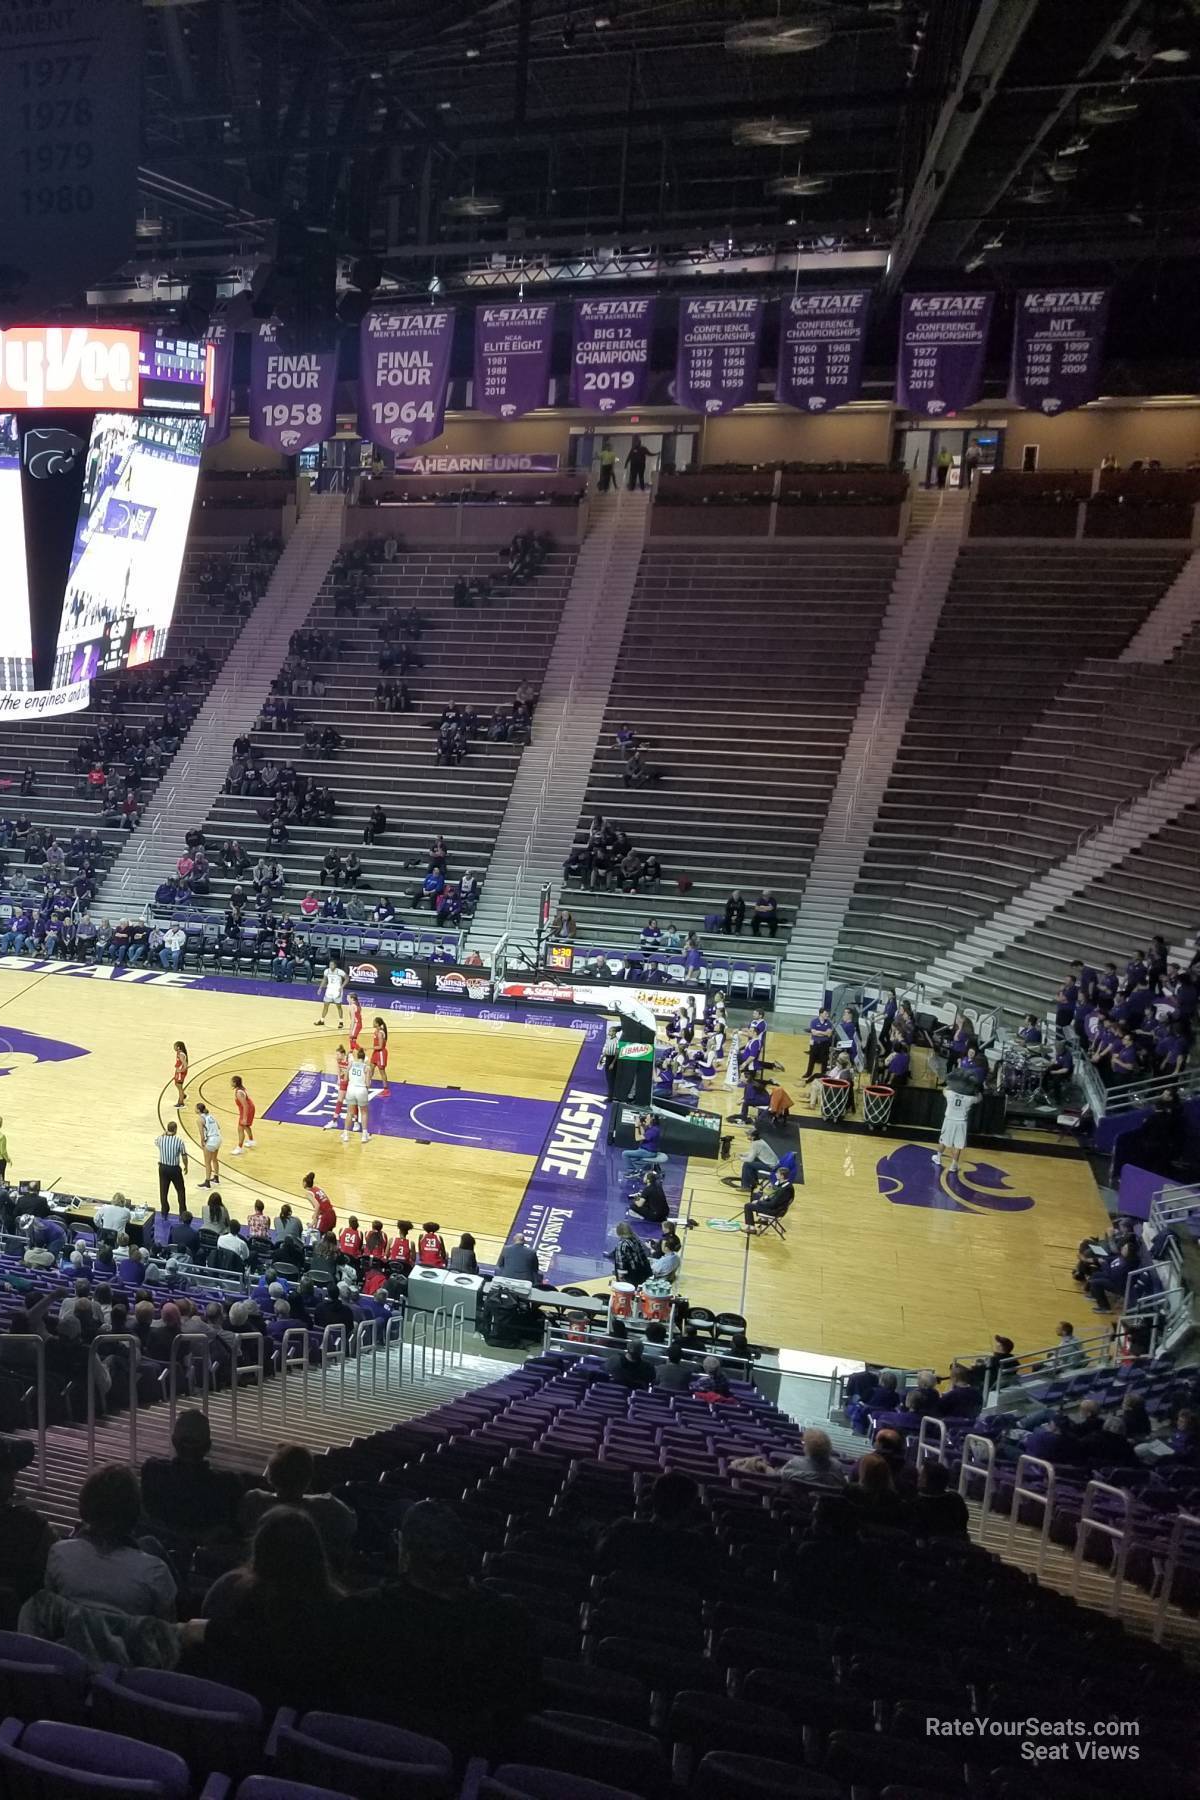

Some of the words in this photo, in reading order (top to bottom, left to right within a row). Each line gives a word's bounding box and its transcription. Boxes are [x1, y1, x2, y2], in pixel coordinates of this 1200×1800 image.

[17, 54, 92, 90] 1977
[19, 97, 94, 131] 1978
[20, 141, 94, 174] 1979
[20, 184, 94, 216] 1980
[790, 294, 863, 311] K-STATE
[909, 297, 986, 311] K-STATE
[1024, 291, 1105, 307] K-STATE
[581, 300, 648, 315] K-STATE
[687, 300, 758, 314] K-STATE
[483, 307, 548, 322] K-STATE
[368, 314, 448, 331] K-STATE
[796, 320, 854, 329] CONFERENCE
[916, 322, 976, 331] CONFERENCE
[1050, 319, 1076, 331] NIT
[373, 330, 395, 338] MEN'S
[396, 329, 441, 337] BASKETBALL
[594, 329, 614, 339] BIG
[617, 328, 631, 338] 12
[685, 332, 756, 342] CHAMPIONSHIPS
[787, 328, 861, 338] CHAMPIONSHIPS
[906, 331, 983, 340] CHAMPIONSHIPS
[484, 341, 511, 352] ELITE
[512, 340, 542, 350] EIGHT
[577, 340, 647, 351] CONFERENCE
[794, 345, 817, 353] 1960
[1028, 344, 1053, 352] 1976
[1065, 342, 1090, 350] 1999
[576, 350, 647, 364] CHAMPIONS
[692, 349, 713, 357] 1917
[914, 348, 938, 356] 1977
[377, 350, 433, 369] FINAL
[488, 357, 507, 365] 1981
[723, 358, 745, 366] 1956
[793, 356, 815, 364] 1961
[827, 355, 849, 363] 1970
[913, 358, 936, 367] 1980
[1026, 354, 1051, 363] 1992
[1062, 353, 1088, 362] 2007
[267, 354, 321, 372] FINAL
[691, 359, 712, 367] 1919
[792, 366, 815, 375] 1963
[826, 365, 848, 374] 1972
[911, 369, 935, 378] 2013
[1025, 366, 1050, 374] 1994
[1060, 365, 1087, 374] 2009
[266, 372, 318, 390] FOUR
[376, 368, 431, 386] FOUR
[485, 377, 506, 386] 2010
[584, 371, 635, 390] 2019
[792, 377, 814, 385] 1964
[825, 376, 848, 384] 1973
[721, 380, 743, 388] 1959
[909, 381, 934, 389] 2019
[485, 387, 506, 396] 2018
[262, 403, 322, 426] 1958
[372, 401, 435, 424] 1964
[0, 693, 21, 710] the
[24, 692, 66, 712] engines
[552, 947, 573, 957] 6:30
[552, 956, 566, 967] 30
[349, 966, 379, 978] Kansas
[435, 975, 466, 987] Kansas
[620, 1045, 651, 1057] LIBMAN
[541, 1089, 609, 1180] K-STATE
[344, 1233, 356, 1244] 24
[425, 1238, 436, 1248] 33
[398, 1246, 404, 1256] 3
